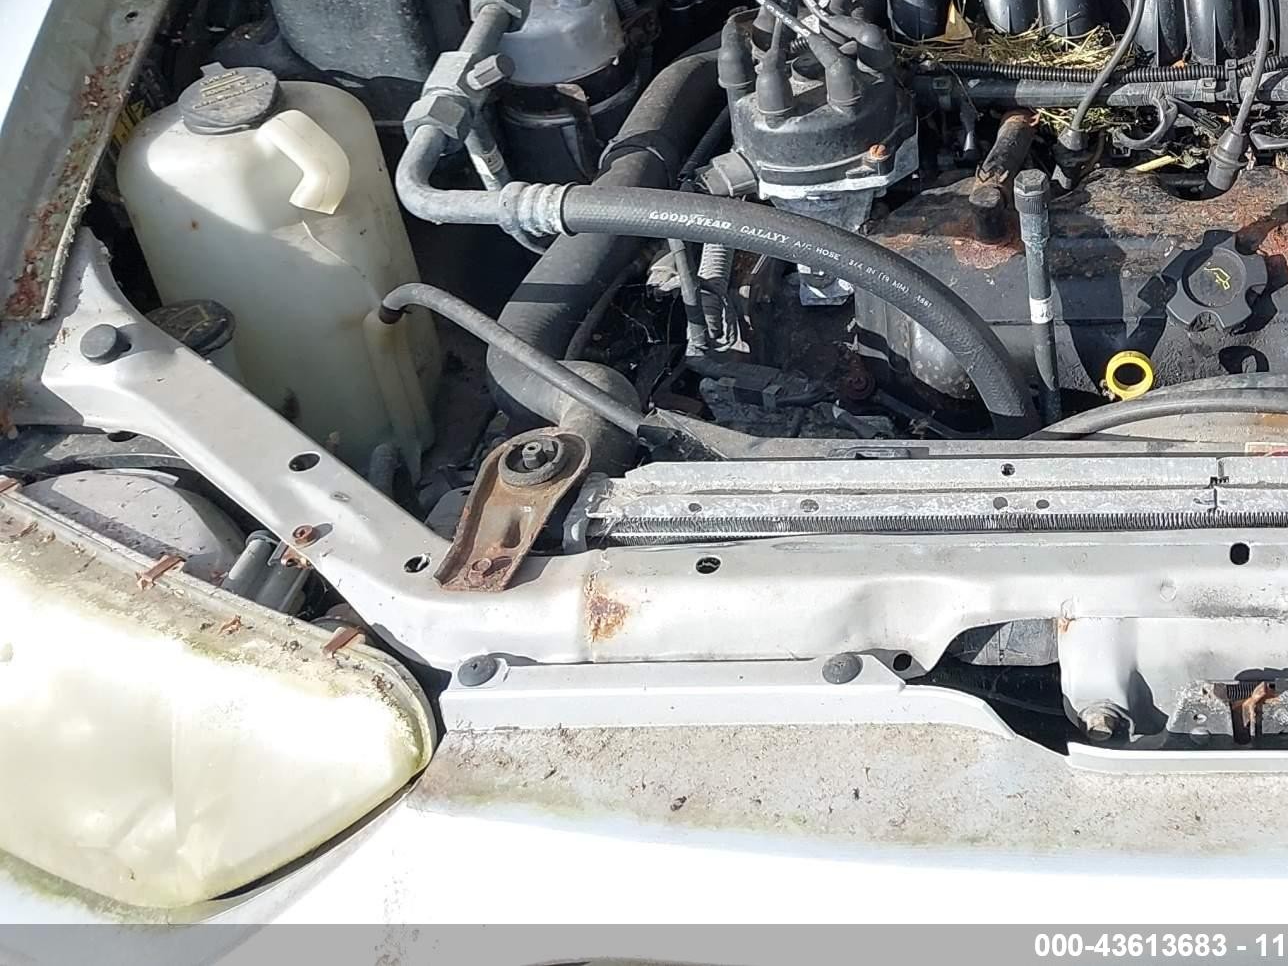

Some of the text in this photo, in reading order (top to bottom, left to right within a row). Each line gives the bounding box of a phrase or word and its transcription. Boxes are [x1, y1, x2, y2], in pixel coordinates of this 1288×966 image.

[648, 210, 790, 244] GOODYEAR GALAXY
[815, 245, 842, 261] HOSE
